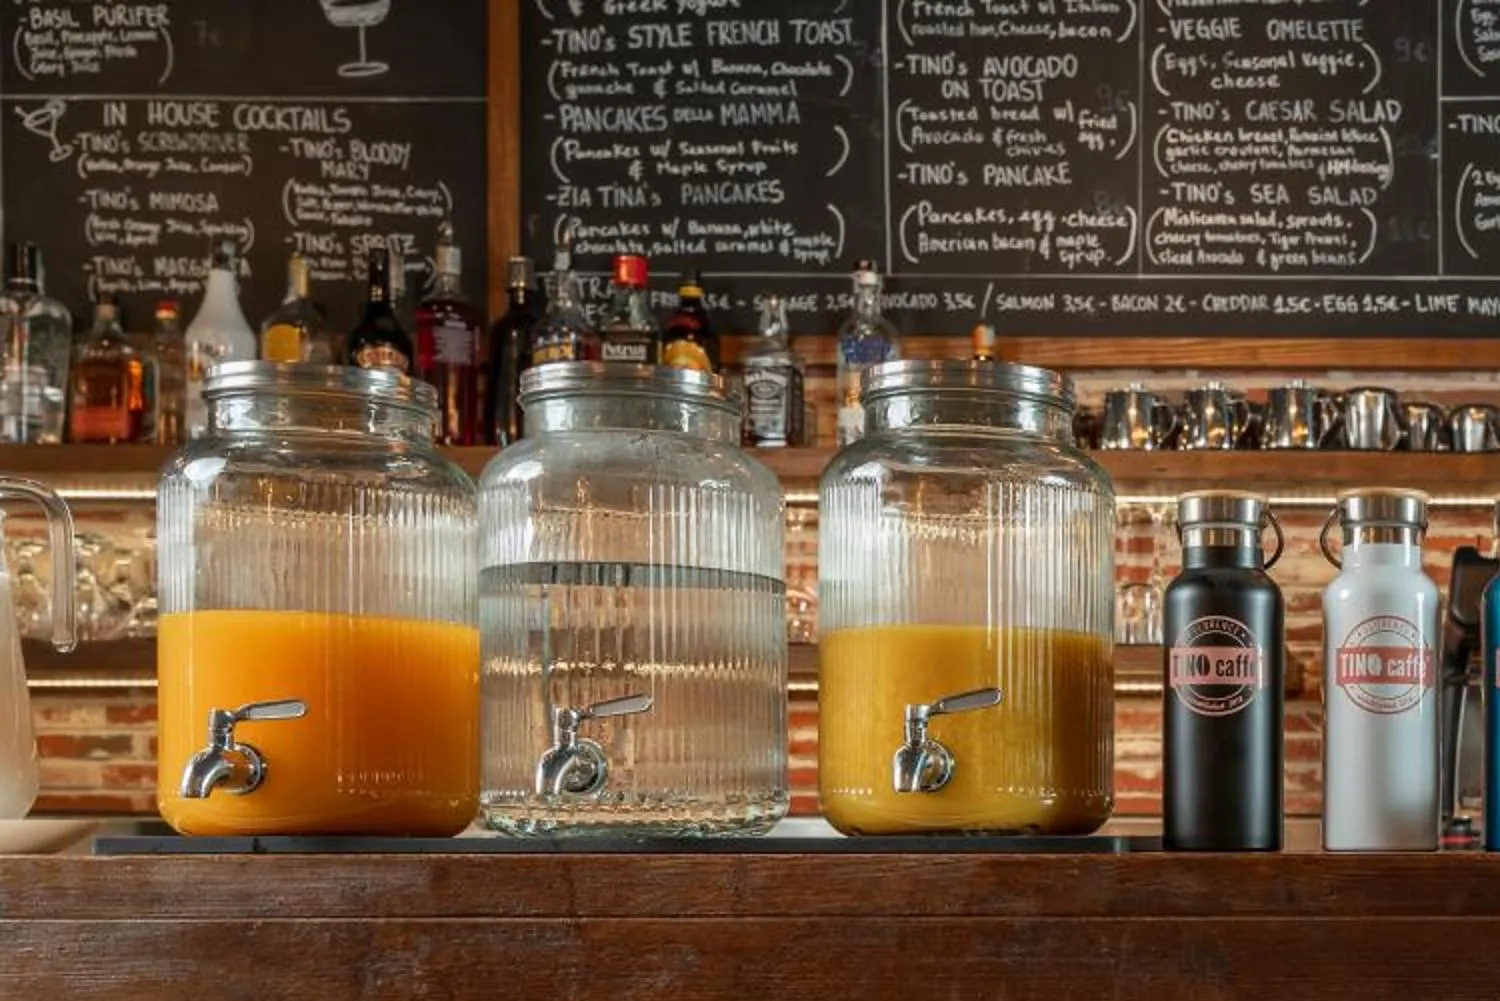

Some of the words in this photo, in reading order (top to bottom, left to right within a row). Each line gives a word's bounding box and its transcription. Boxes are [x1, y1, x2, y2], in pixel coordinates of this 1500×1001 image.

[627, 22, 694, 49] STYLE
[706, 19, 780, 47] FRENCH
[788, 17, 854, 46] TOAST
[1168, 16, 1244, 42] VEGGIE
[1265, 17, 1365, 43] OMELETTE
[560, 60, 621, 78] French
[982, 53, 1079, 79] AVOCADO
[940, 79, 971, 99] ON
[978, 78, 1046, 102] TOAST
[1210, 72, 1281, 90] cheese
[103, 102, 127, 127] IN
[148, 102, 220, 128] HOUSE
[233, 103, 352, 134] COCKTAILS
[558, 103, 669, 132] PANCAKES
[718, 100, 801, 127] MAMMA
[904, 105, 980, 122] Toasted
[1244, 99, 1318, 123] CAESAR
[1328, 98, 1404, 124] SALAD
[910, 125, 985, 145] Avocado
[1165, 126, 1235, 145] Chicken
[349, 138, 412, 171] BLOODY
[321, 160, 370, 182] MARY
[983, 161, 1073, 187] PANCAKE
[149, 191, 220, 214] MIMOSA
[680, 178, 786, 206] PANCAKES
[1249, 183, 1291, 205] SEA
[1307, 185, 1378, 207] SALAD
[1414, 293, 1460, 313] LIME
[1340, 652, 1383, 678] TINO
